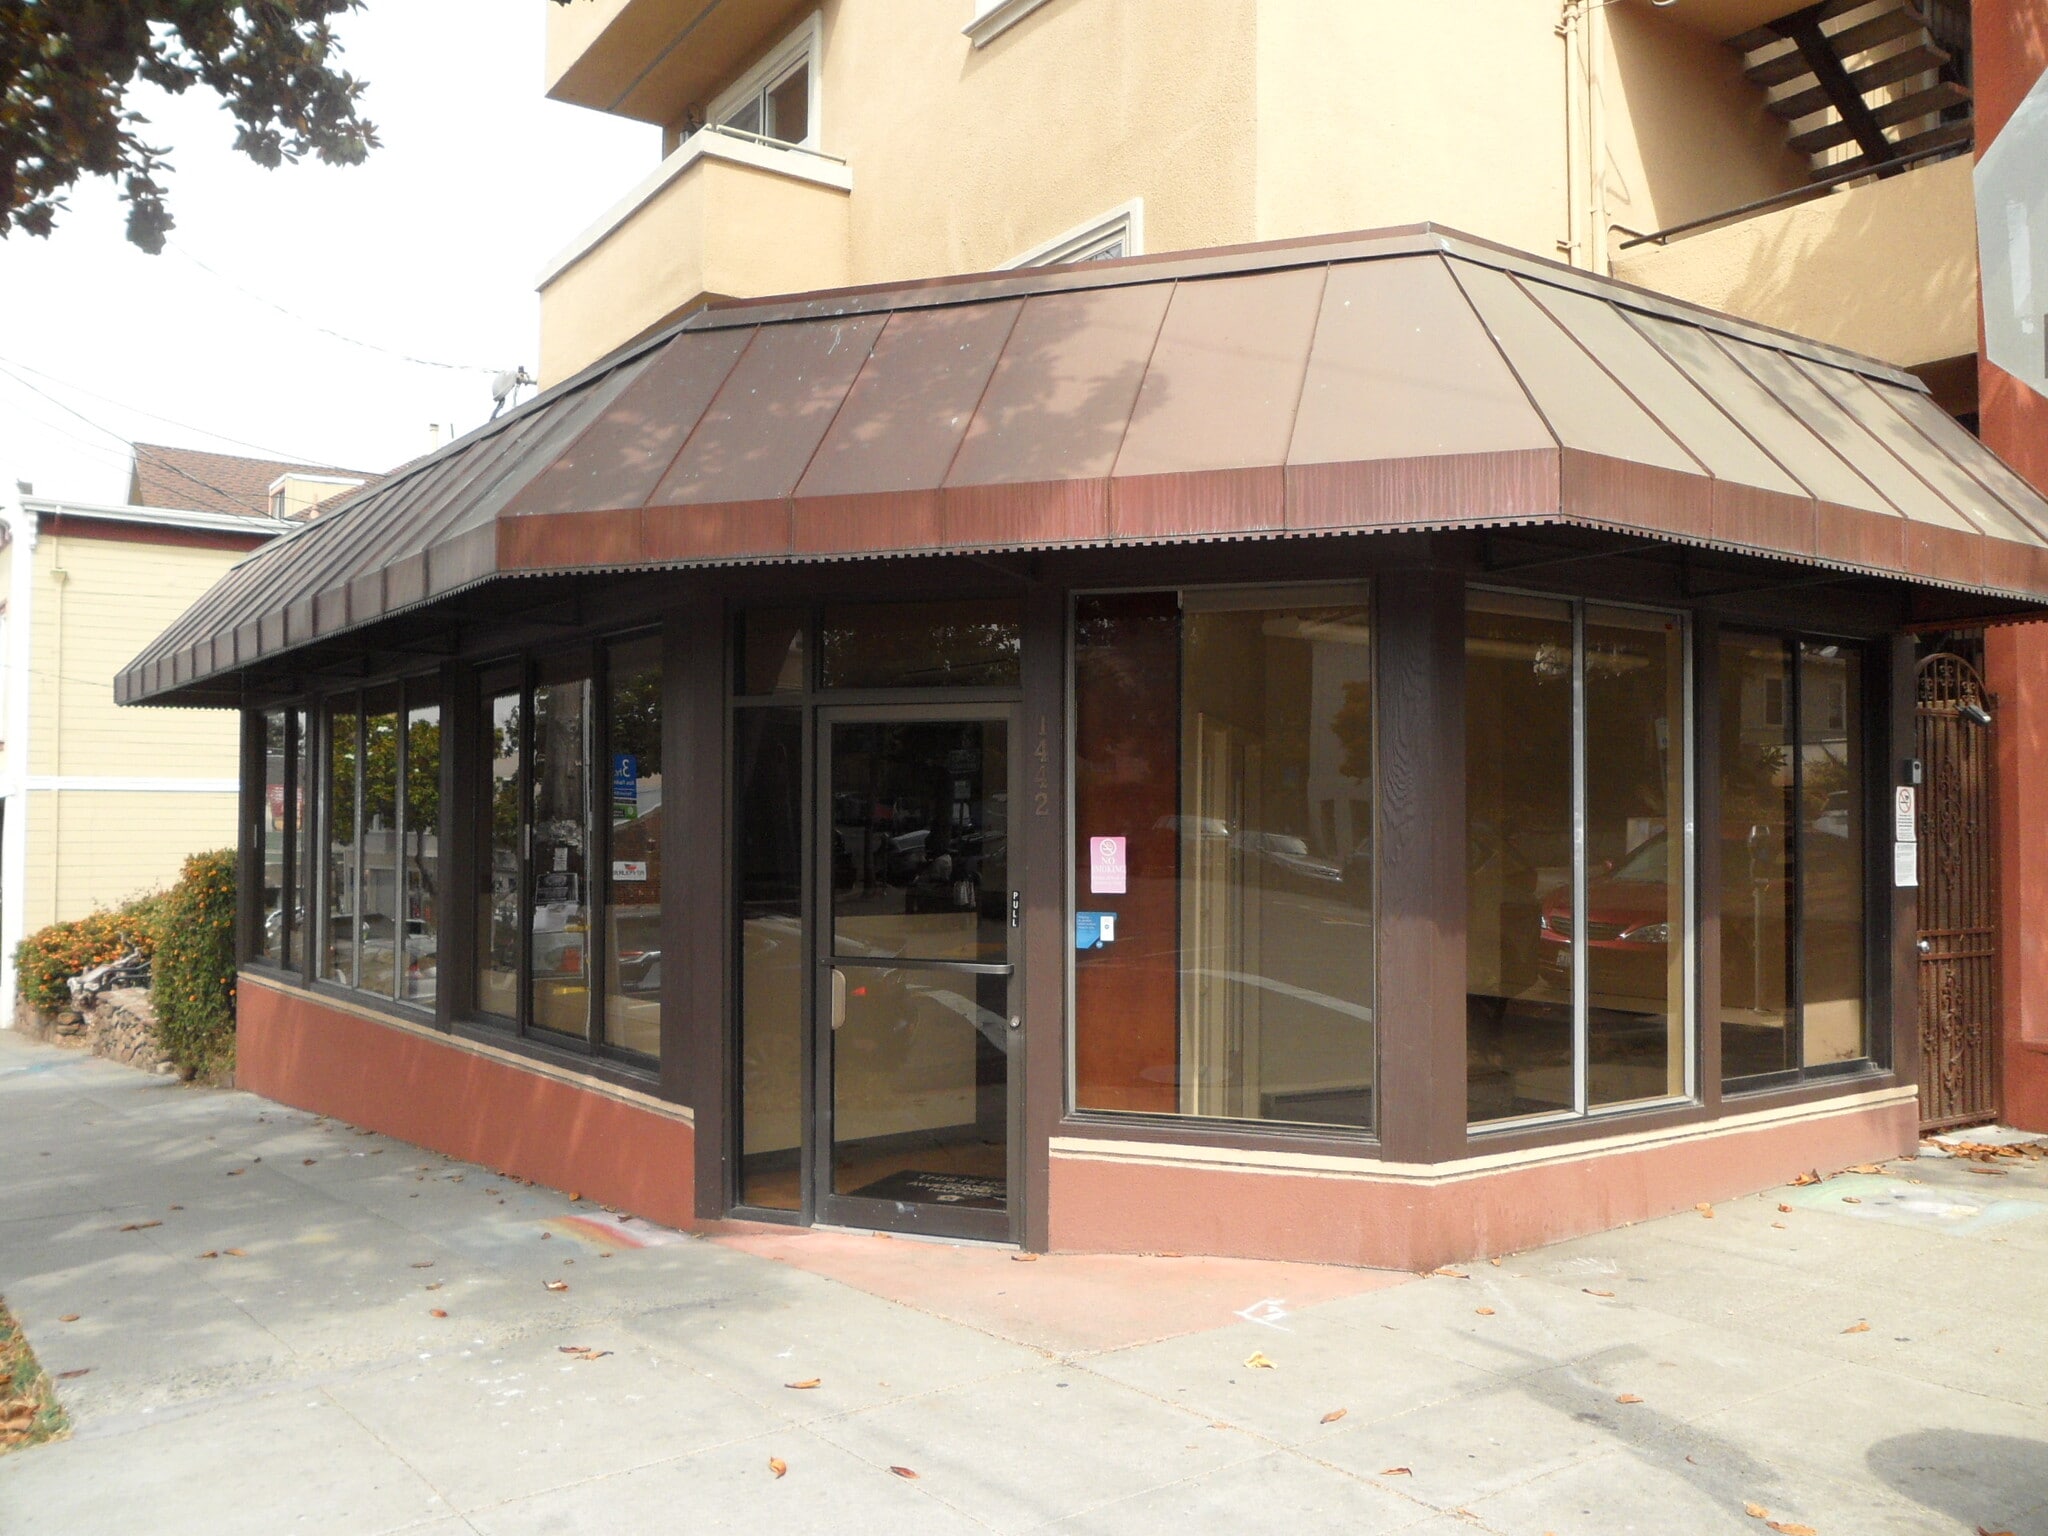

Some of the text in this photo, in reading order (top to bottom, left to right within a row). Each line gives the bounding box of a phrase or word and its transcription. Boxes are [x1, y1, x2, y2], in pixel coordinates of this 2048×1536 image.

[1034, 714, 1049, 816] 1442
[1102, 856, 1116, 865] NO
[1011, 891, 1020, 927] PULL
